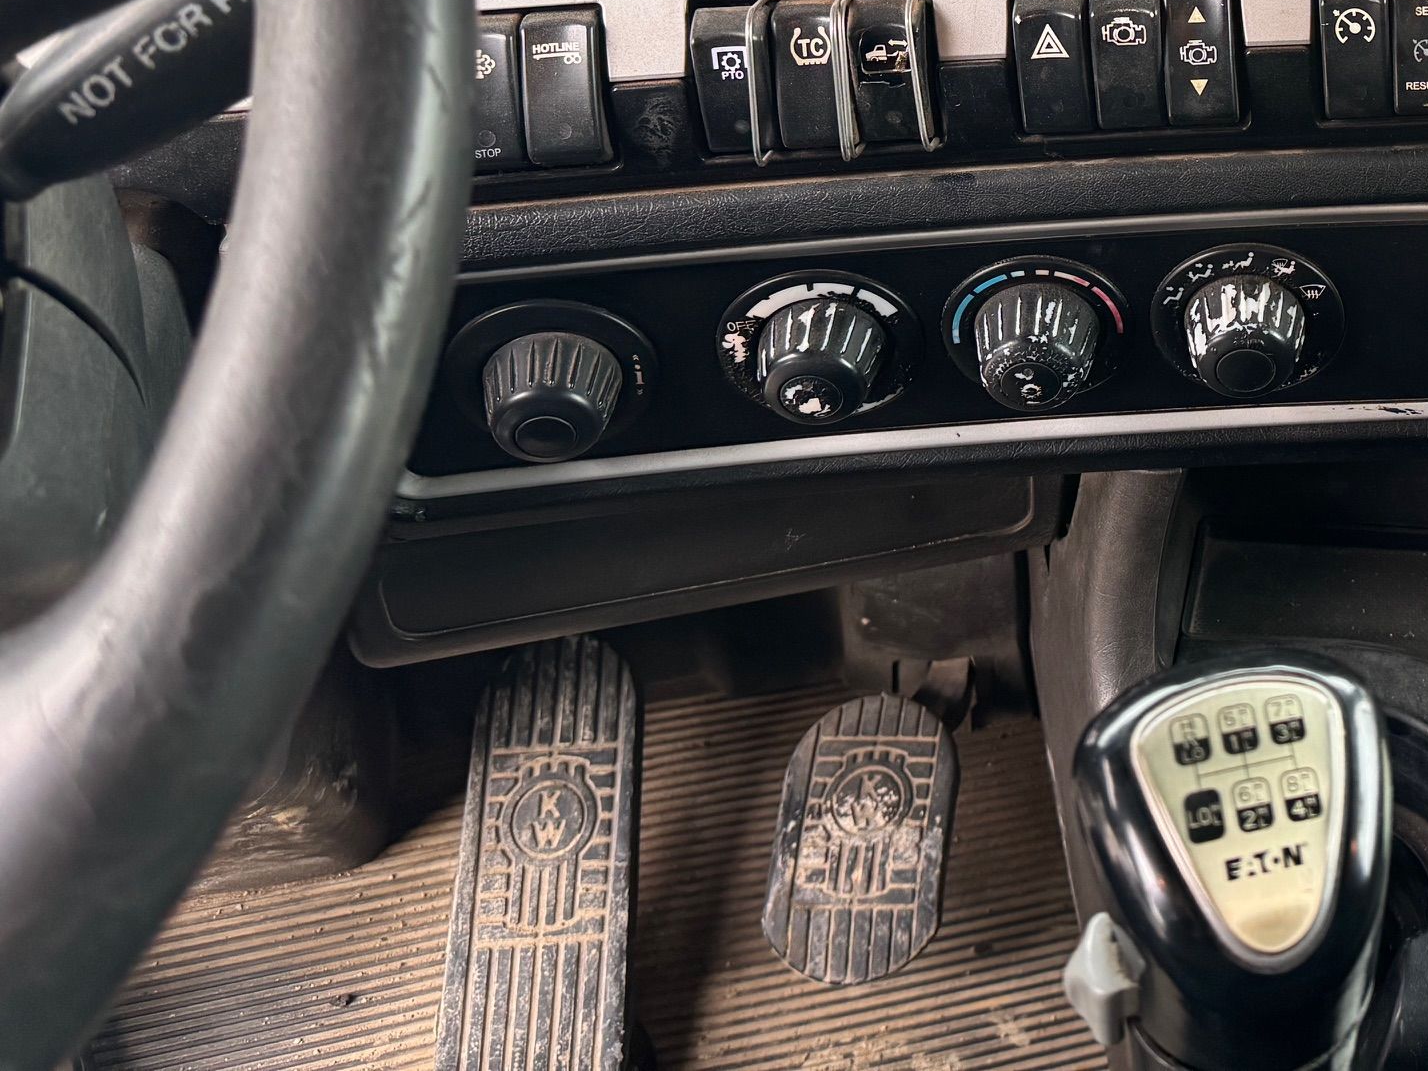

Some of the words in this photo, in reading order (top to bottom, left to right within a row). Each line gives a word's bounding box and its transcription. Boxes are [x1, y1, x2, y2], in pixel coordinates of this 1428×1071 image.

[532, 42, 580, 54] HOTLINE
[798, 38, 825, 57] TC
[58, 55, 132, 125] NOT
[133, 3, 213, 70] FOR
[721, 70, 744, 80] PTO
[475, 148, 501, 159] STOP
